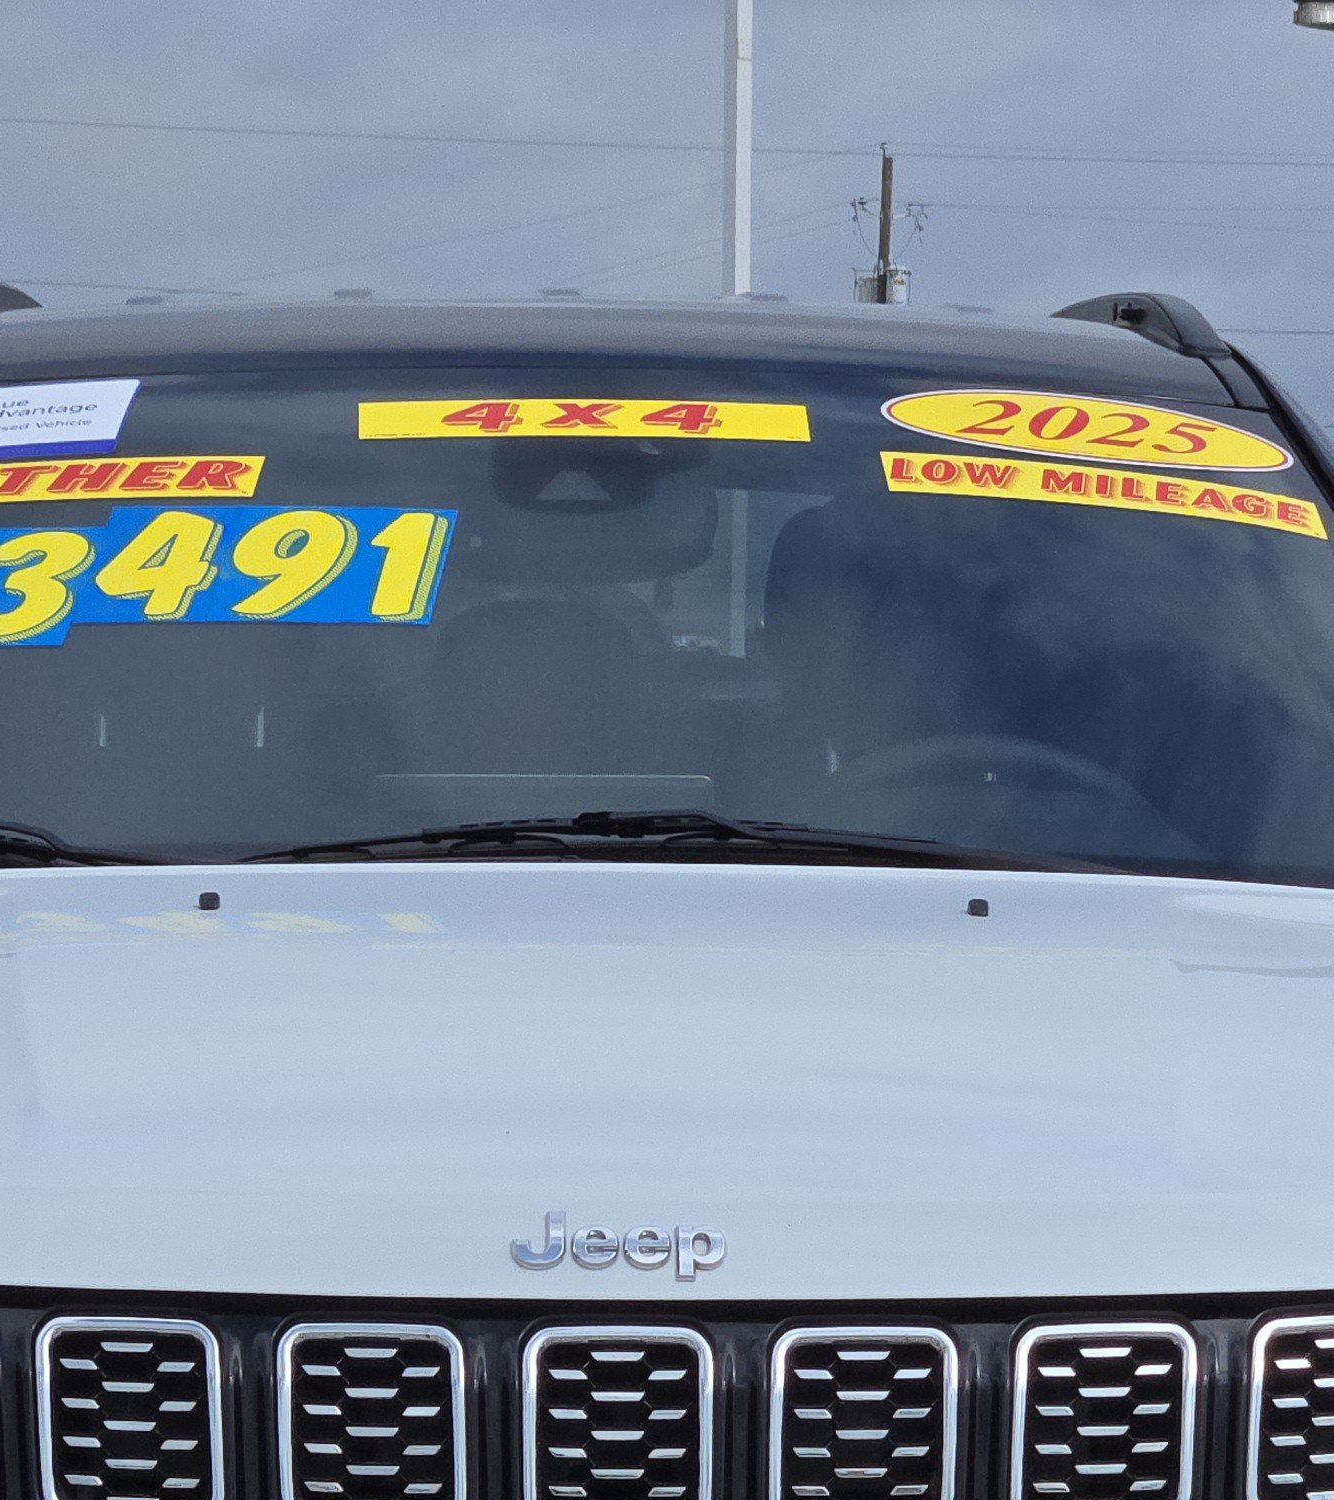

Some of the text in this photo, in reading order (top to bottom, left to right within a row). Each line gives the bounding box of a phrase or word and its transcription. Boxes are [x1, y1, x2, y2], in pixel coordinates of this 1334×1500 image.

[35, 418, 92, 429] Vehicle
[954, 399, 1219, 454] 2025
[890, 457, 1313, 526] LOW MILEAGE
[511, 1210, 727, 1282] Jeep
